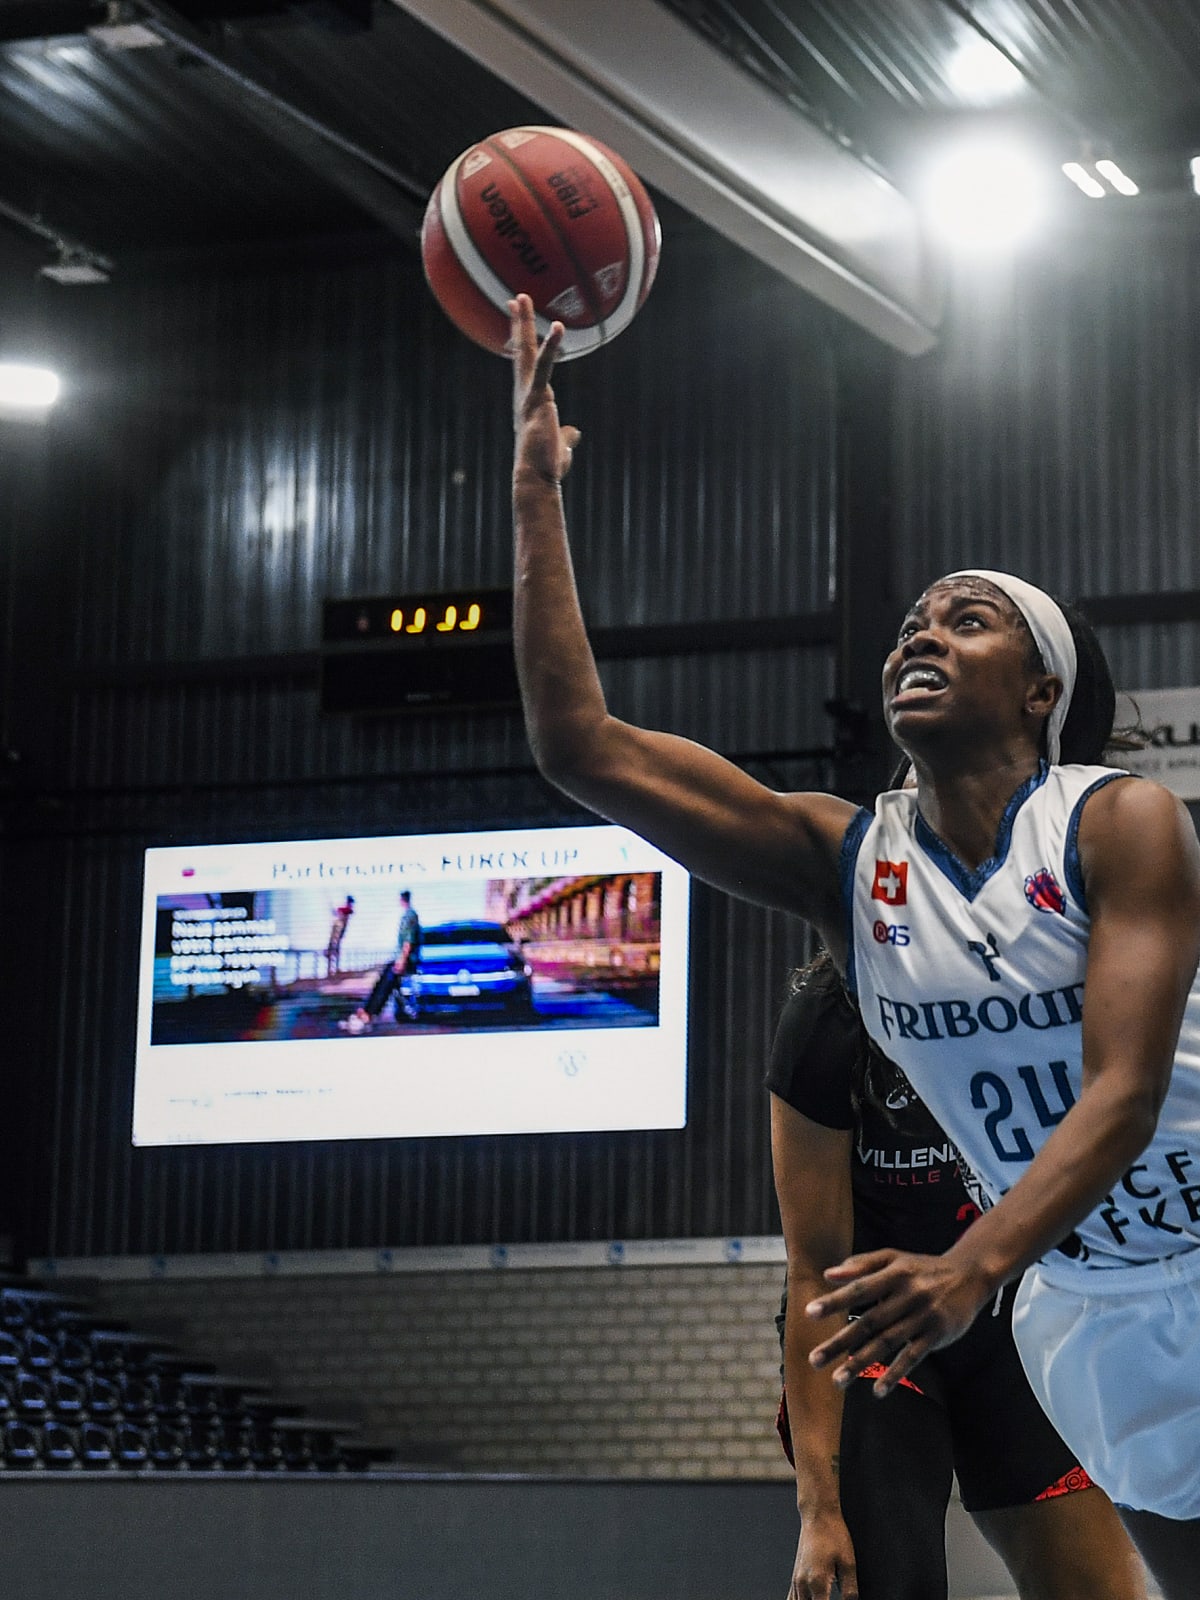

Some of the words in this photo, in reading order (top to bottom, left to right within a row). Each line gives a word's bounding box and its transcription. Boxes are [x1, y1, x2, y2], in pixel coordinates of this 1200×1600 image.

[479, 181, 550, 277] molten
[876, 982, 1085, 1041] FRIBOU
[856, 1143, 957, 1169] VILLEN
[873, 1169, 942, 1186] LILLE
[1103, 1150, 1193, 1207] CF
